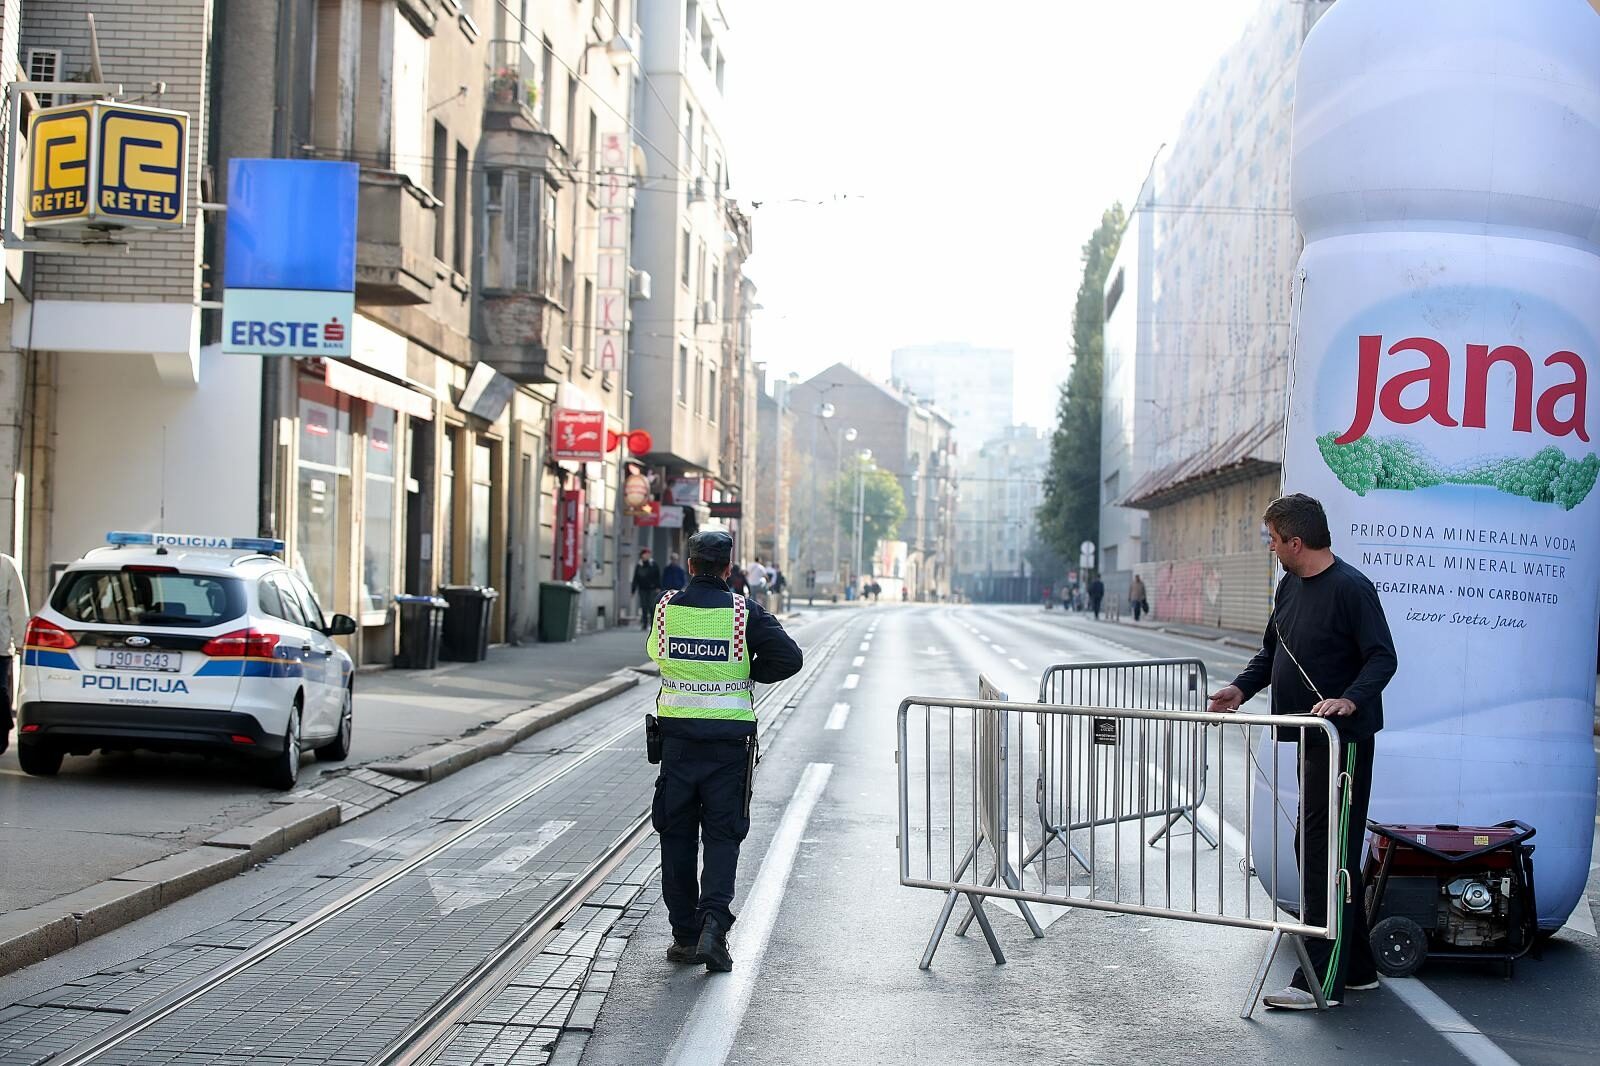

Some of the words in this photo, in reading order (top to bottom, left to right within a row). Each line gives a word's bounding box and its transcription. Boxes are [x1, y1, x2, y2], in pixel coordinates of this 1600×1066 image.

[32, 190, 85, 212] RETEL
[102, 190, 176, 215] RETEL
[231, 320, 318, 347] ERSTE
[1334, 335, 1590, 445] Jana
[156, 535, 228, 548] POLICIJA
[1350, 523, 1435, 540] PRIRODNA
[1443, 527, 1538, 547] MINERALNA
[1544, 536, 1576, 552] VODA
[1362, 552, 1436, 568] NATURAL
[1444, 556, 1517, 574] MINERAL
[1523, 562, 1566, 579] WATER
[1371, 581, 1445, 596] EGAZIRANA
[1457, 586, 1484, 599] NON
[1489, 588, 1558, 605] CARBONATED
[1406, 607, 1446, 623] izvor
[1449, 611, 1491, 627] Sveta
[1491, 615, 1527, 629] Jana
[110, 652, 133, 665] 190
[143, 653, 169, 667] 643
[670, 642, 727, 657] POLICIJA
[82, 674, 190, 694] POLICIJA
[680, 682, 721, 692] POLICIJA
